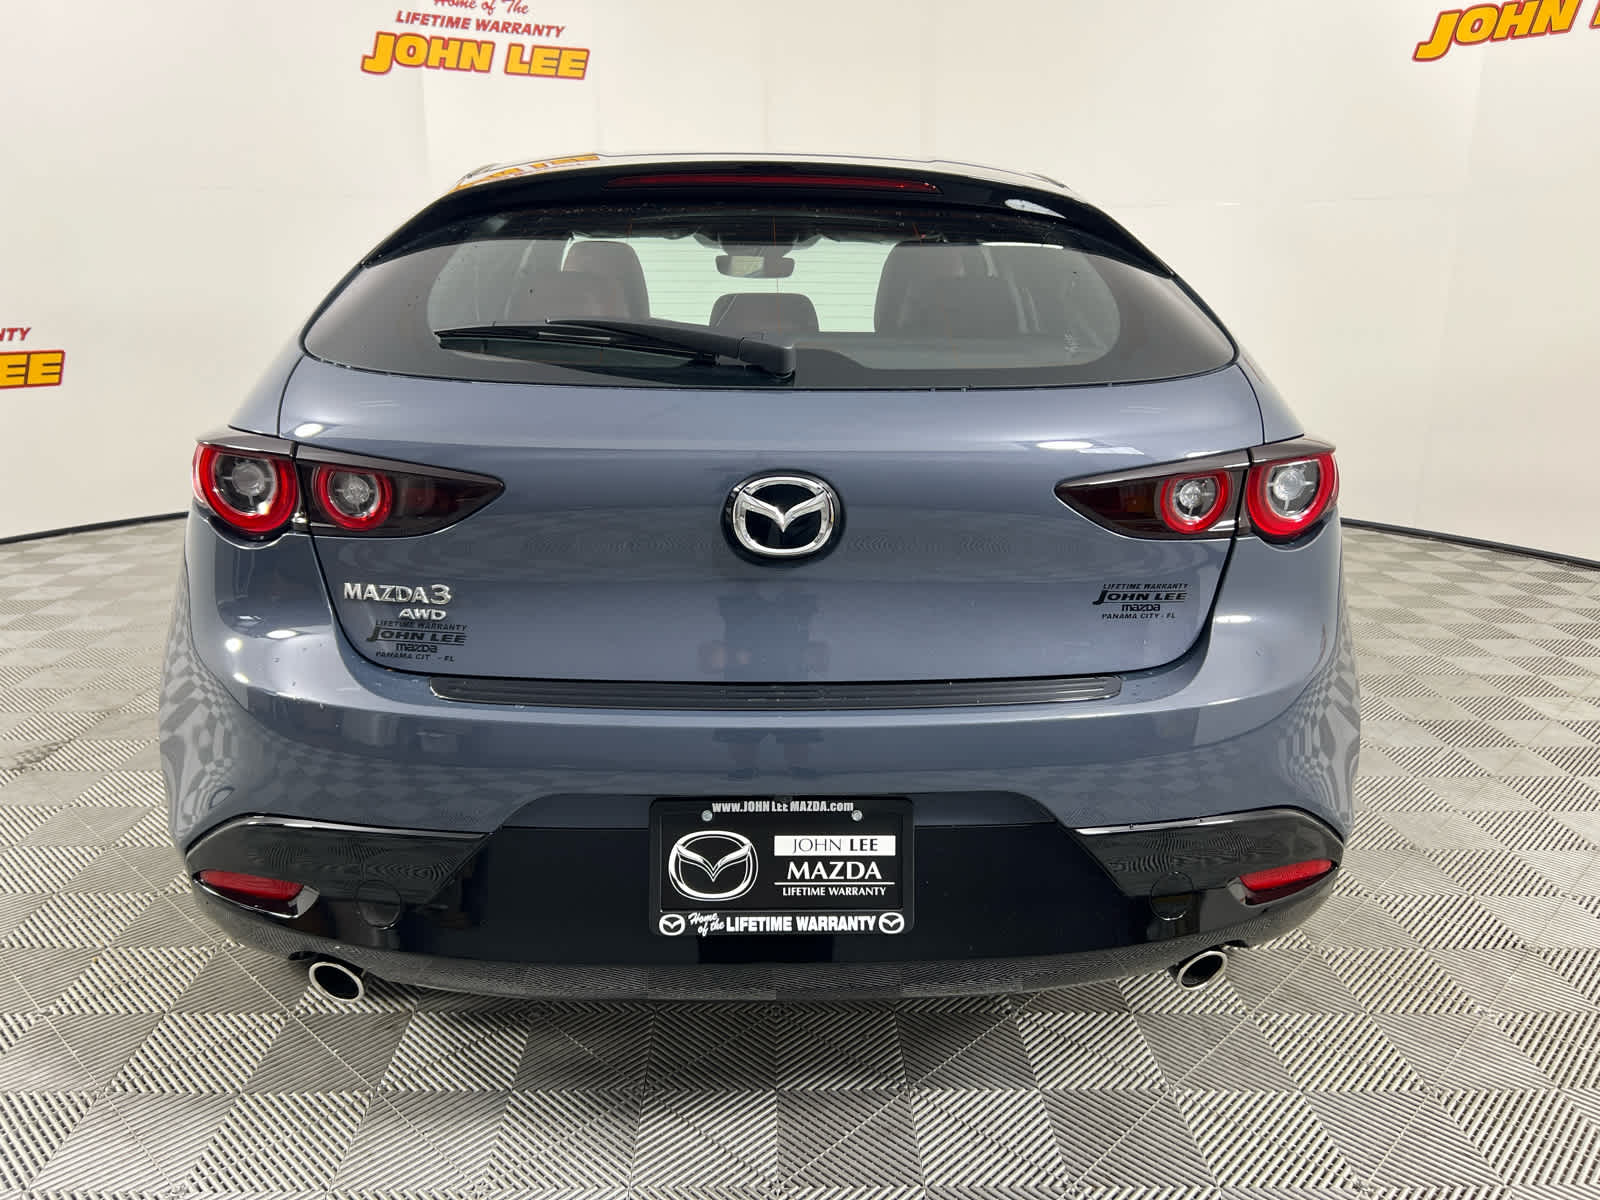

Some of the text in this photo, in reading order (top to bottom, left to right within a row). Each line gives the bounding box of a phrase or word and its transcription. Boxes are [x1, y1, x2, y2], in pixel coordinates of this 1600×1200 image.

[481, 0, 496, 16] of
[501, 0, 528, 14] The
[396, 10, 566, 38] LIFETIME WARRANTY
[1412, 0, 1583, 62] JOHN
[361, 31, 590, 80] JOHN LEE
[1092, 590, 1149, 605] JOHN
[398, 608, 447, 621] AWD
[419, 622, 467, 631] WARRANTY
[366, 627, 467, 643] JOHN LEE
[792, 838, 879, 853] JOHN LEE
[787, 861, 882, 880] MAZDA
[782, 887, 887, 897] LIFETIME WARRANTY
[688, 912, 718, 925] Home
[726, 915, 877, 932] LIFETIME WARRANTY
[698, 918, 725, 937] of the
